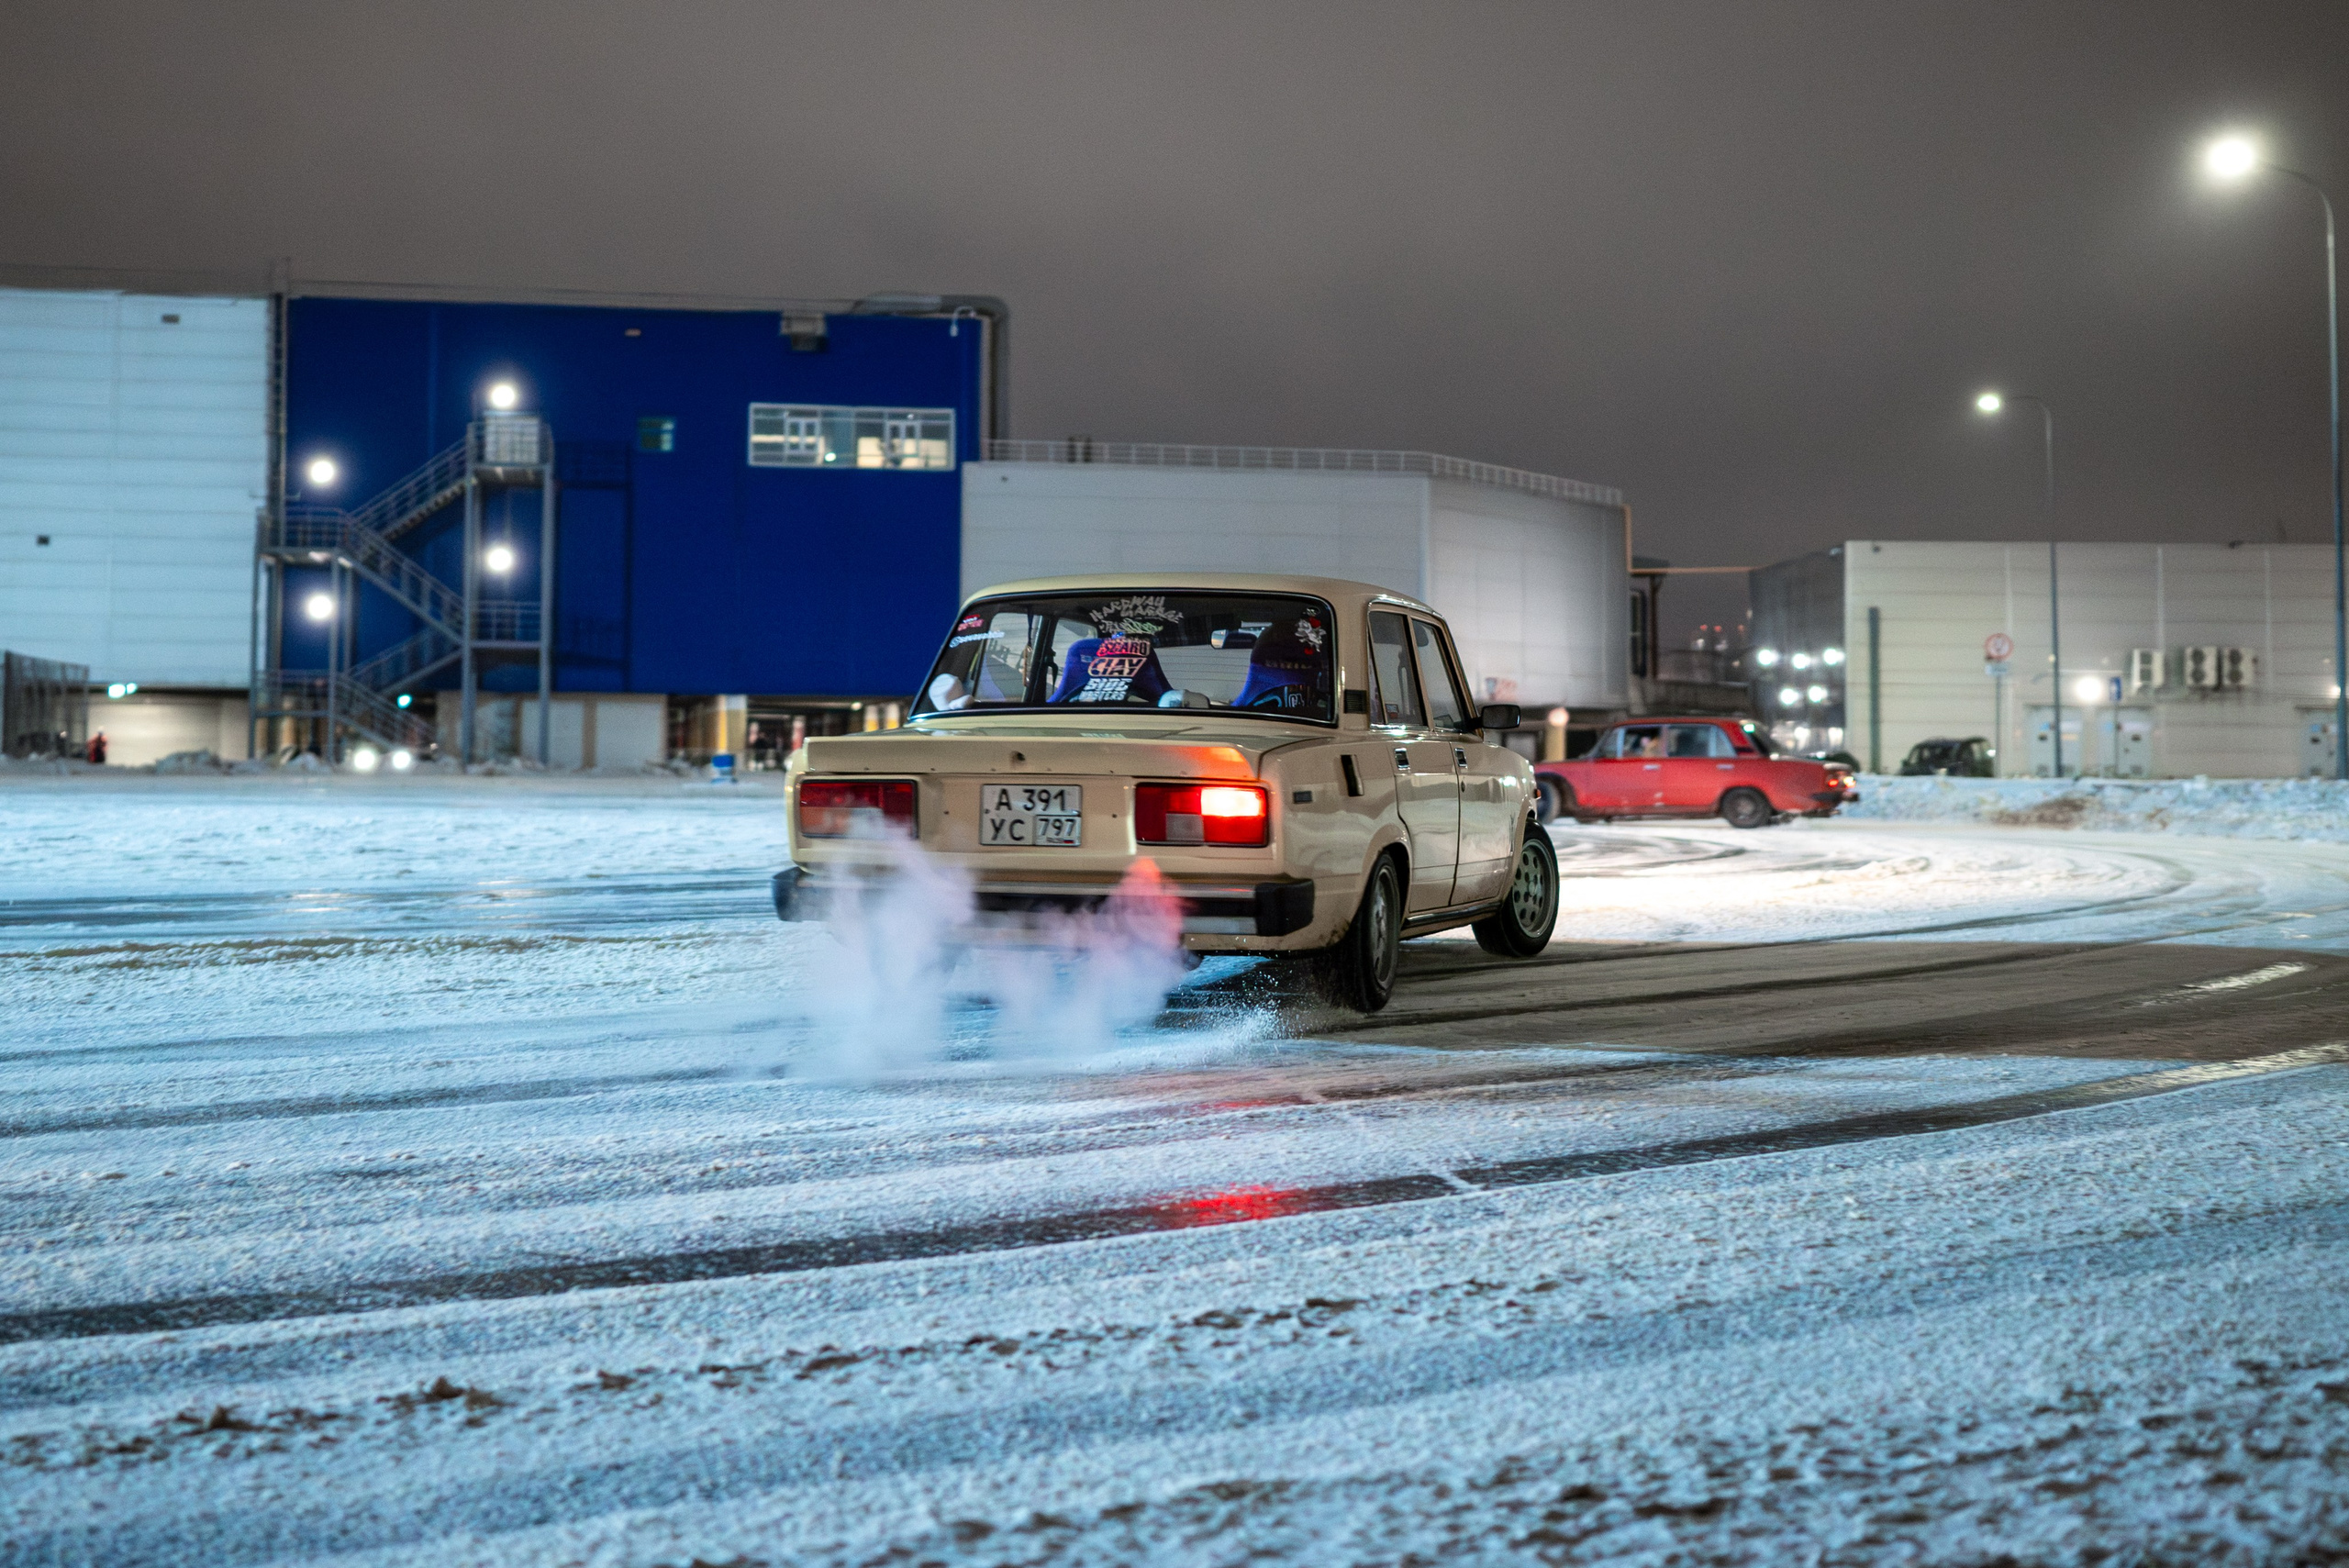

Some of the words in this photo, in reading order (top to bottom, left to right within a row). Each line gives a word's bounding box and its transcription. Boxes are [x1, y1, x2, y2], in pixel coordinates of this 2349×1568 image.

[1084, 677, 1133, 691] SIDE
[995, 788, 1012, 811] А
[1022, 788, 1066, 812] 391
[990, 818, 1026, 841] УС
[1039, 818, 1077, 837] 797
